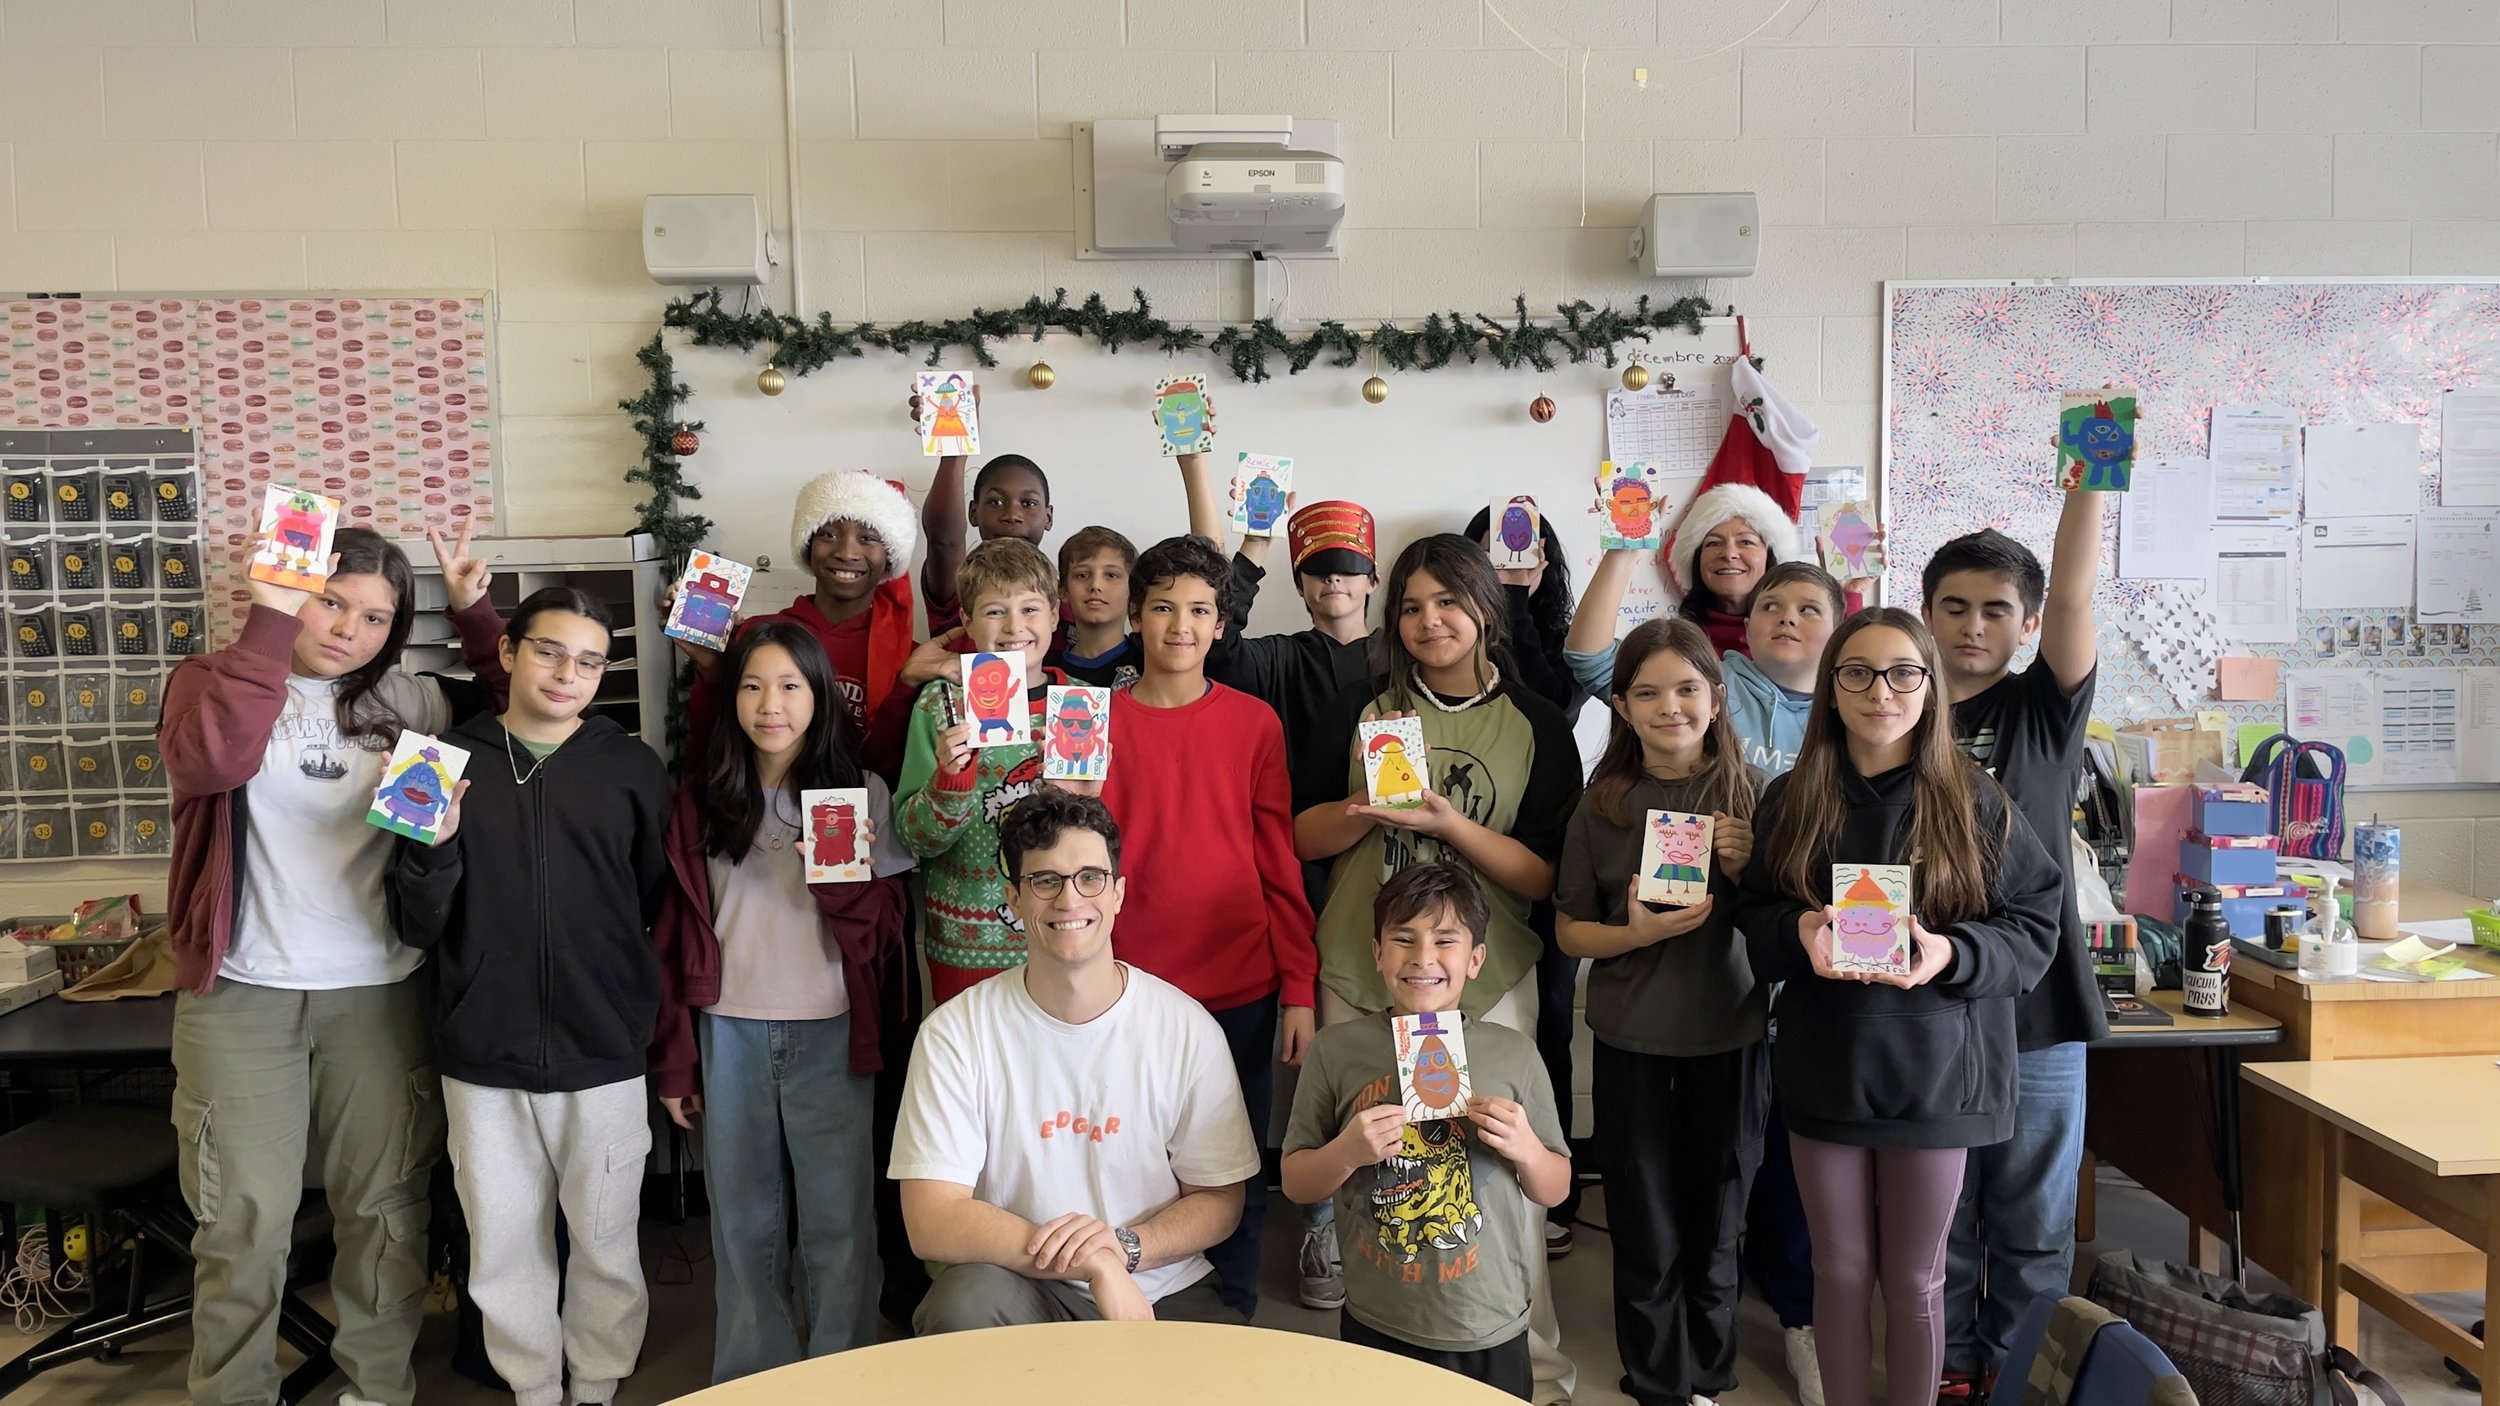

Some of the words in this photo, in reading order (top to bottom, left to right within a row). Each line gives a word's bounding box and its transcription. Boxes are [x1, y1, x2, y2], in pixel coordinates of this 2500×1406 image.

[1248, 169, 1275, 177] EPSON
[1627, 348, 1705, 364] décembre
[1040, 1110, 1121, 1143] EDGAR
[1438, 1242, 1480, 1284] ME
